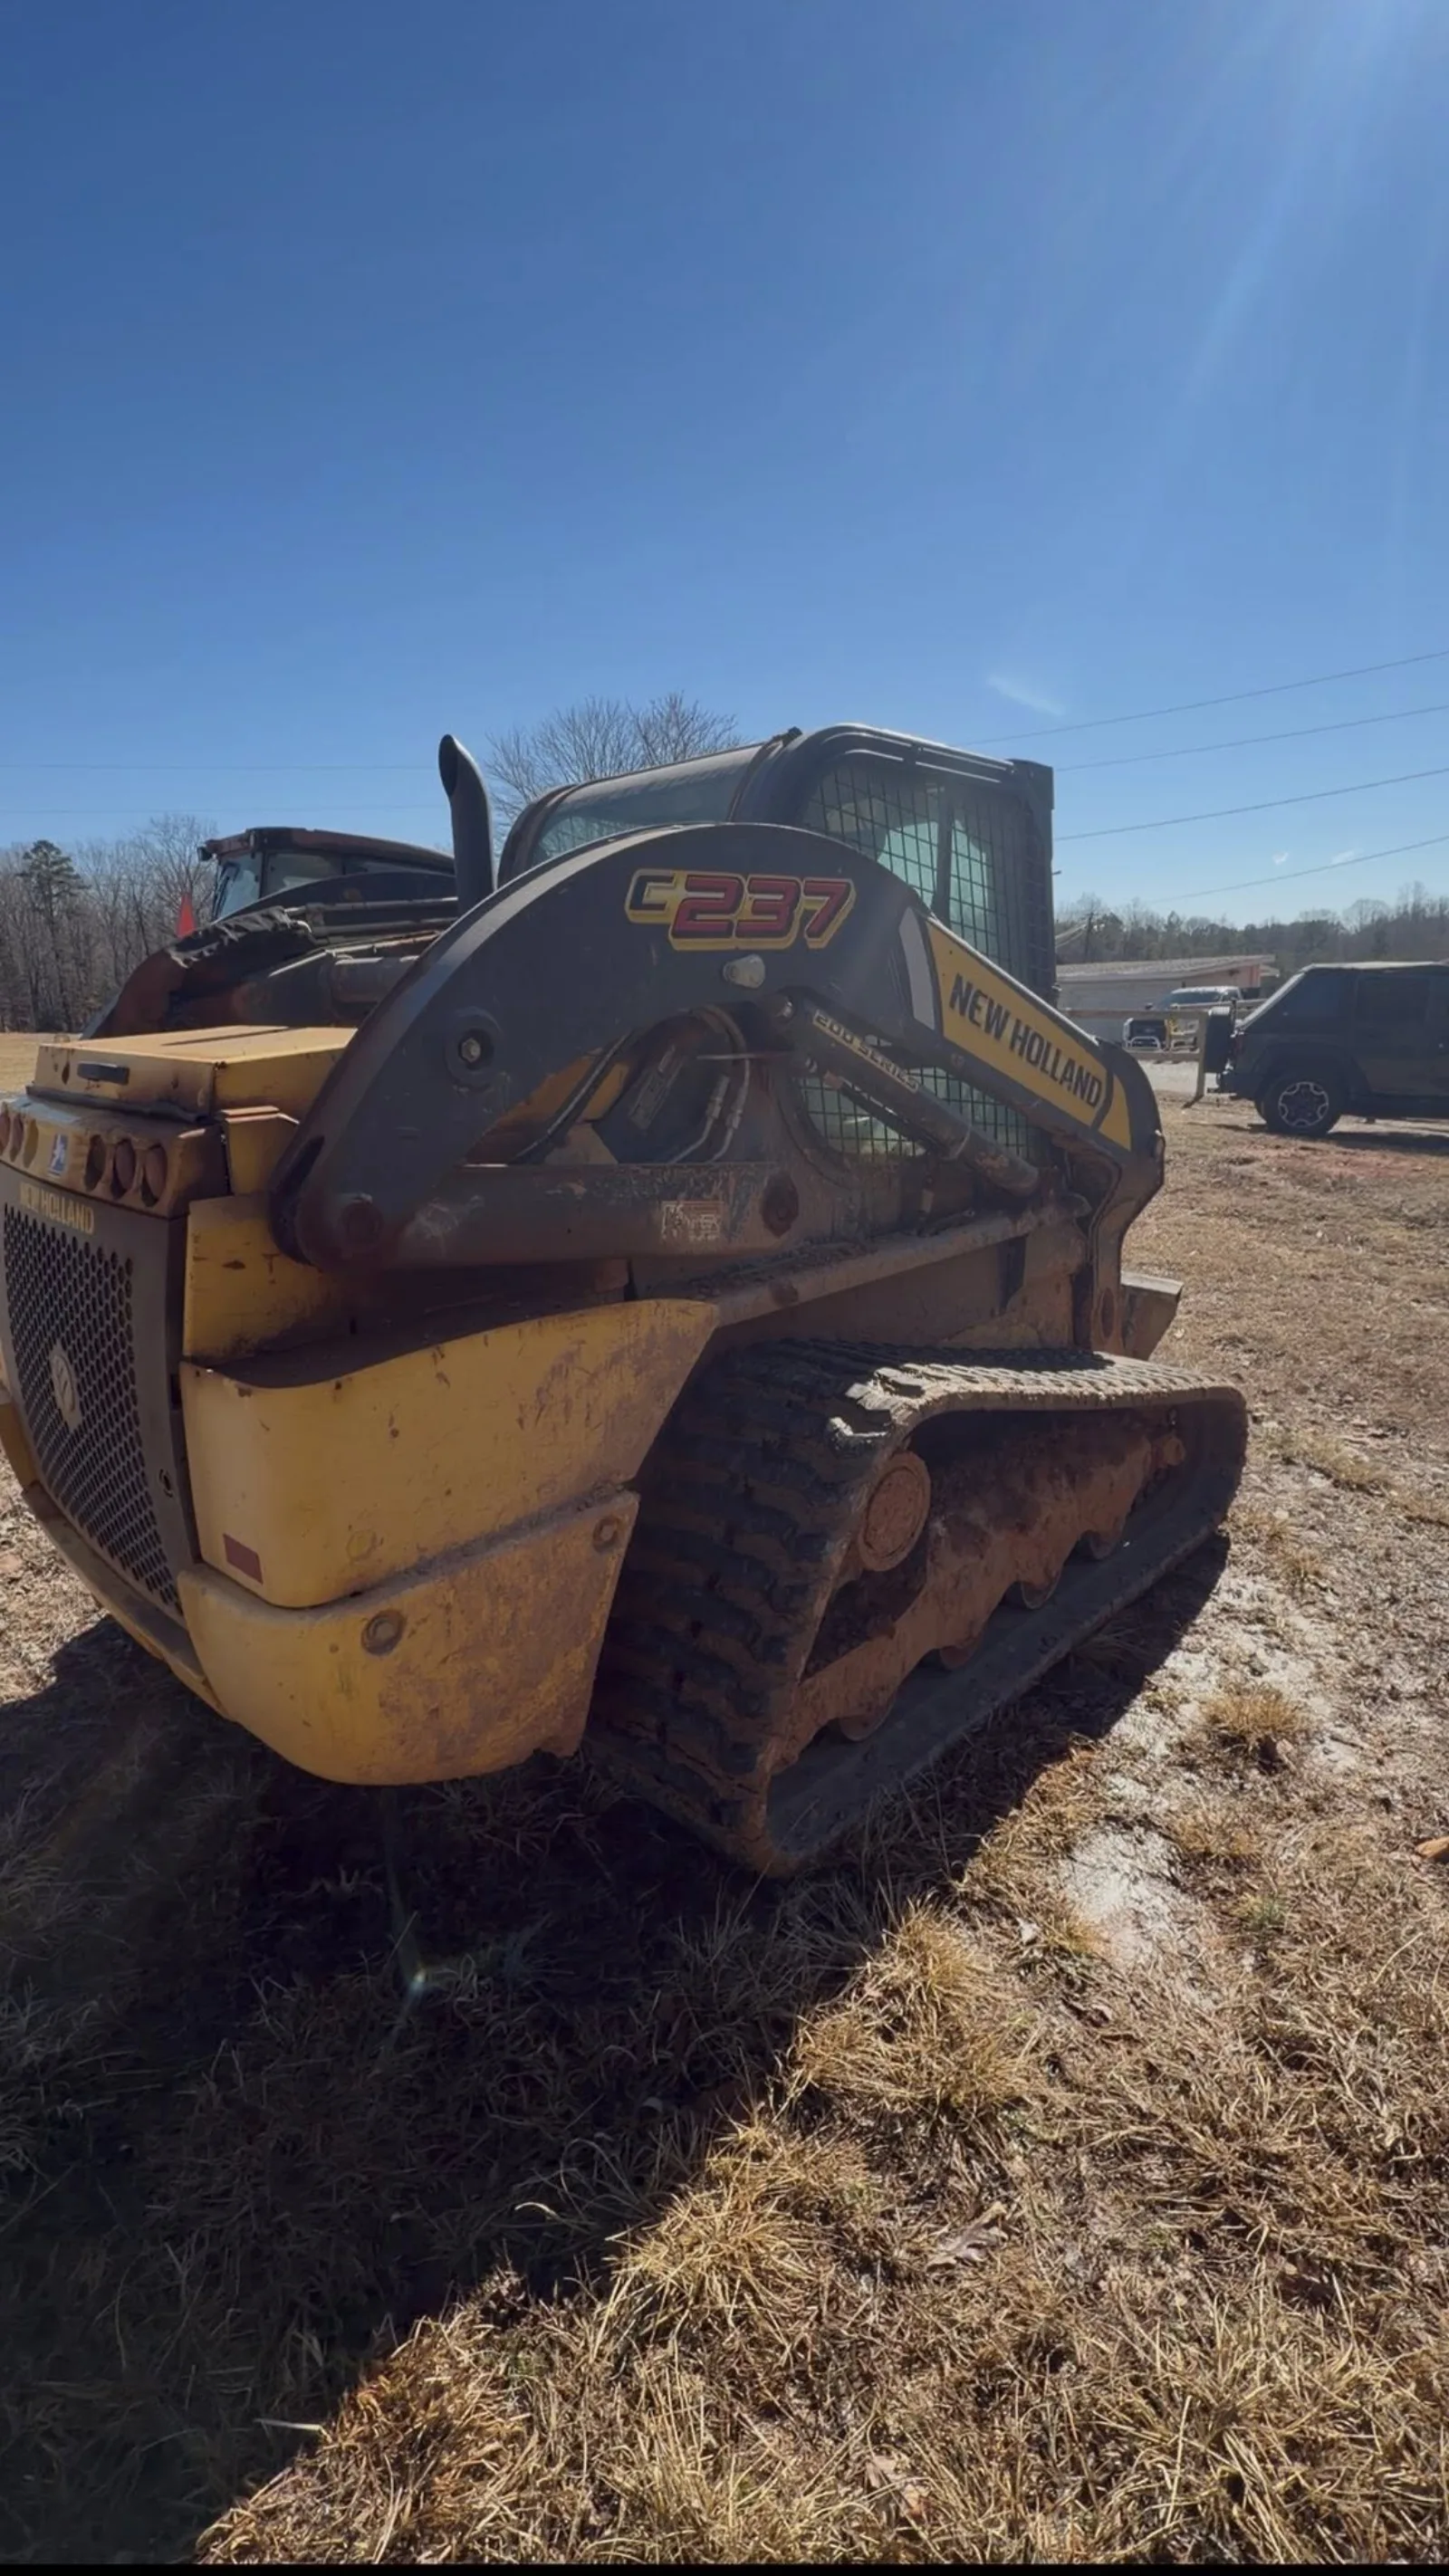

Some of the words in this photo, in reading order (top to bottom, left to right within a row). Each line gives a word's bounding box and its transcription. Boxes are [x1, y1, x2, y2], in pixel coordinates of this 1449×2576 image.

[948, 972, 1011, 1039] NEW
[1009, 1020, 1103, 1107] HOLLAND
[41, 1187, 94, 1236] HOLLAND
